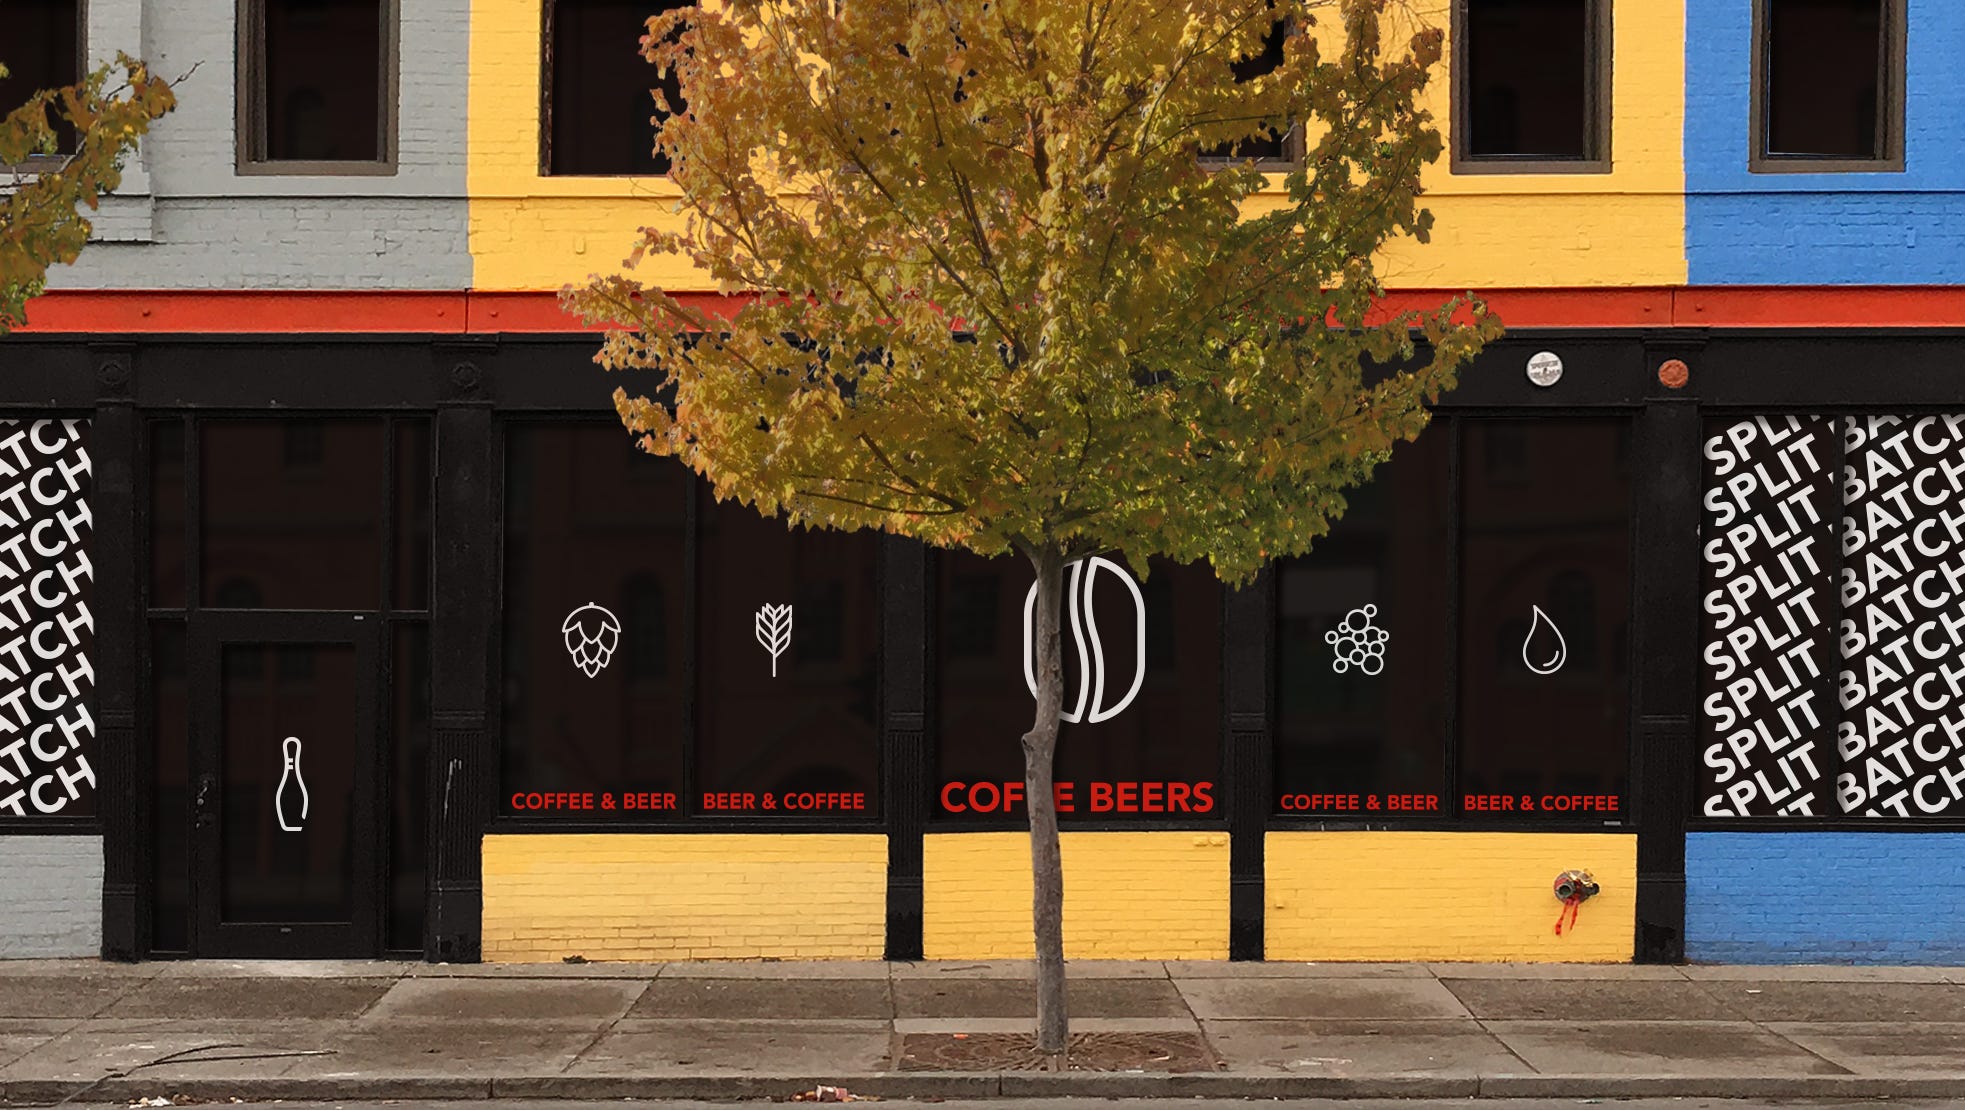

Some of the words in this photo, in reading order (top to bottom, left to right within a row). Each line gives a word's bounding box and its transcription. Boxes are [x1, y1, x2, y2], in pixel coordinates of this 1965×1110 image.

[1703, 432, 1821, 527] SPLIT
[1703, 483, 1821, 578] SPLIT
[1703, 535, 1821, 630] SPLIT
[1703, 586, 1821, 681] SPLIT
[1703, 637, 1821, 732] SPLIT
[1703, 689, 1821, 783] SPLIT
[511, 792, 594, 810] COFFEE
[600, 792, 616, 810] &
[623, 792, 676, 810] BEER
[703, 792, 756, 810] BEER
[761, 792, 777, 810] &
[783, 792, 865, 810] COFFEE
[940, 781, 1075, 813] COFE
[1090, 781, 1214, 813] BEERS
[1280, 794, 1360, 810] COFFEE
[1365, 794, 1381, 810] &
[1387, 794, 1439, 811] BEER
[1464, 795, 1514, 811] BEER
[1520, 795, 1535, 811] &
[1540, 795, 1619, 811] COFFEE
